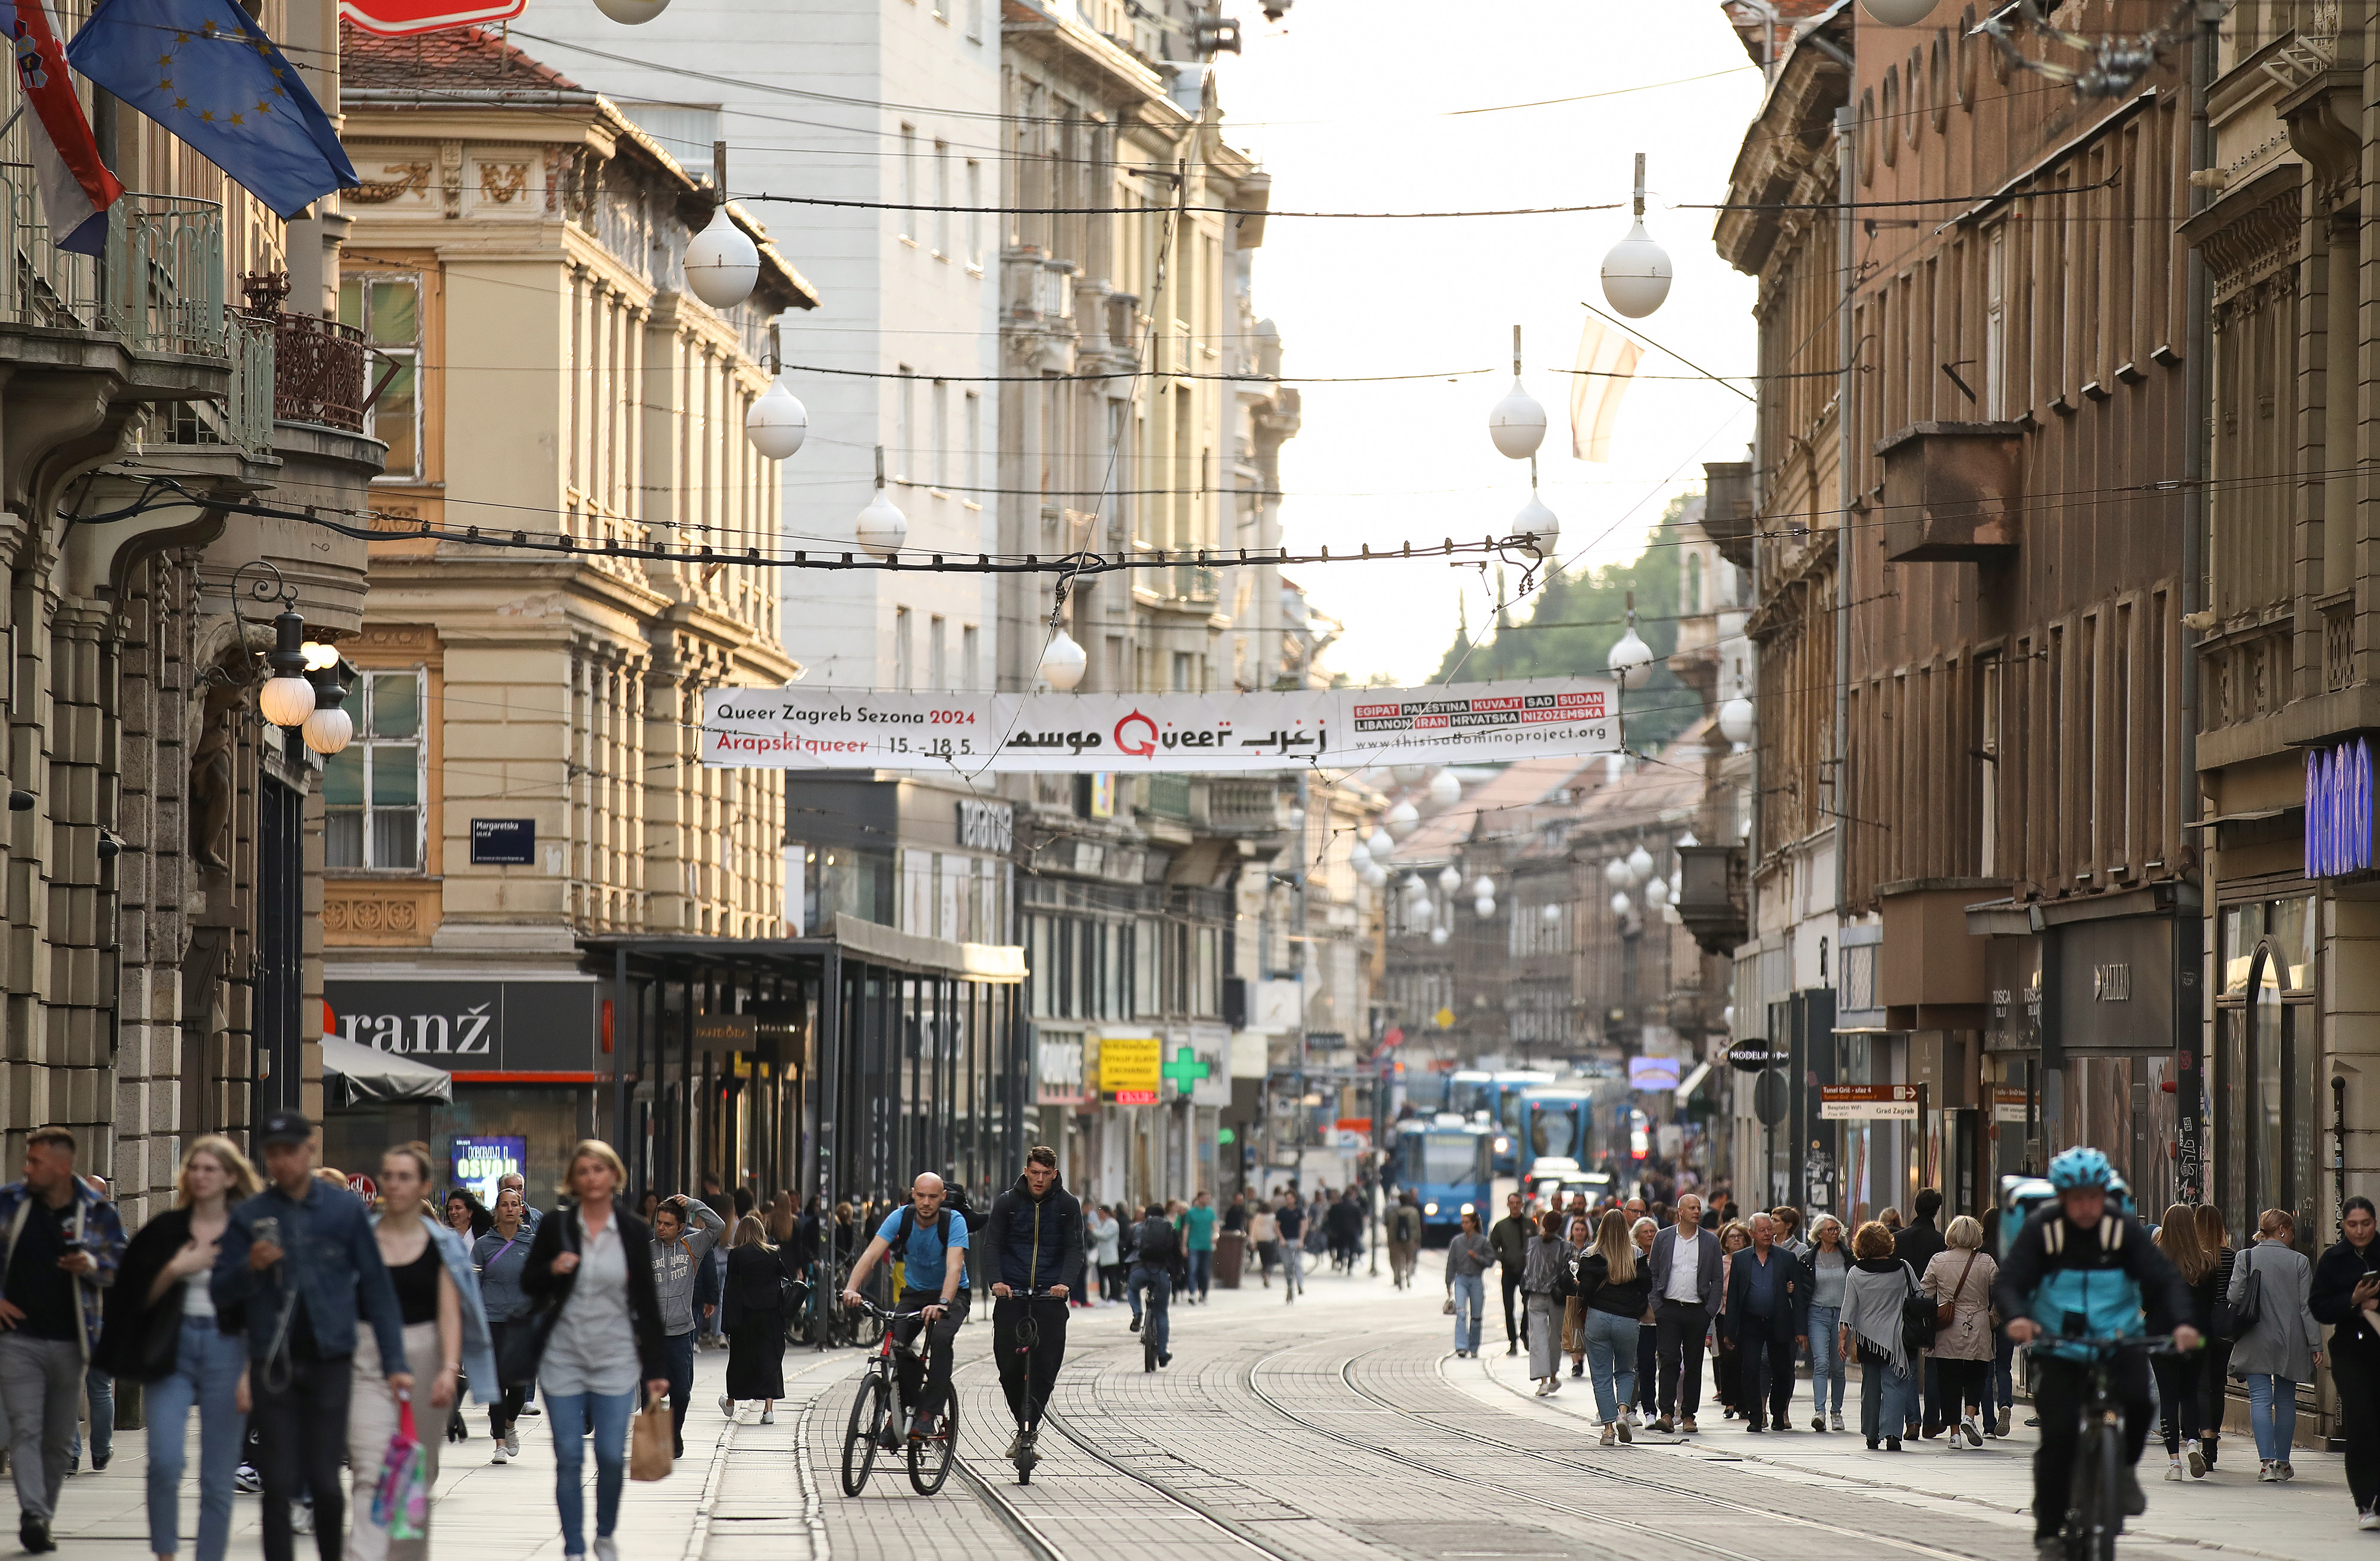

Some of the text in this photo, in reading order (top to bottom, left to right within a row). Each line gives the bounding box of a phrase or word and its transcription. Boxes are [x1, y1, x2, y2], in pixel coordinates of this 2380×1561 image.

[717, 704, 976, 725] Queer Zagreb Sezona 2024
[1356, 692, 1603, 717] EGIPAT PALESTINA KUVAJT SAD SUDAN
[1357, 707, 1604, 731] LIBANON IRAN HRVATSKA NIZOZEMSKA
[717, 731, 800, 754] Arapski
[805, 740, 869, 754] queer
[890, 737, 913, 753] 15.
[932, 738, 955, 755] 18.
[960, 738, 975, 755] 5.
[1355, 727, 1606, 749] www.thisisadominoproject.org
[476, 821, 519, 831] Margaretska
[2102, 963, 2130, 1002] GALILEO
[1993, 990, 2011, 1004] TOSCA
[2024, 988, 2042, 1003] TOSCA
[1996, 1007, 2006, 1018] BLU
[2028, 1004, 2037, 1017] BLU
[323, 997, 491, 1054] ranž
[458, 1158, 517, 1179] OSVOJI
